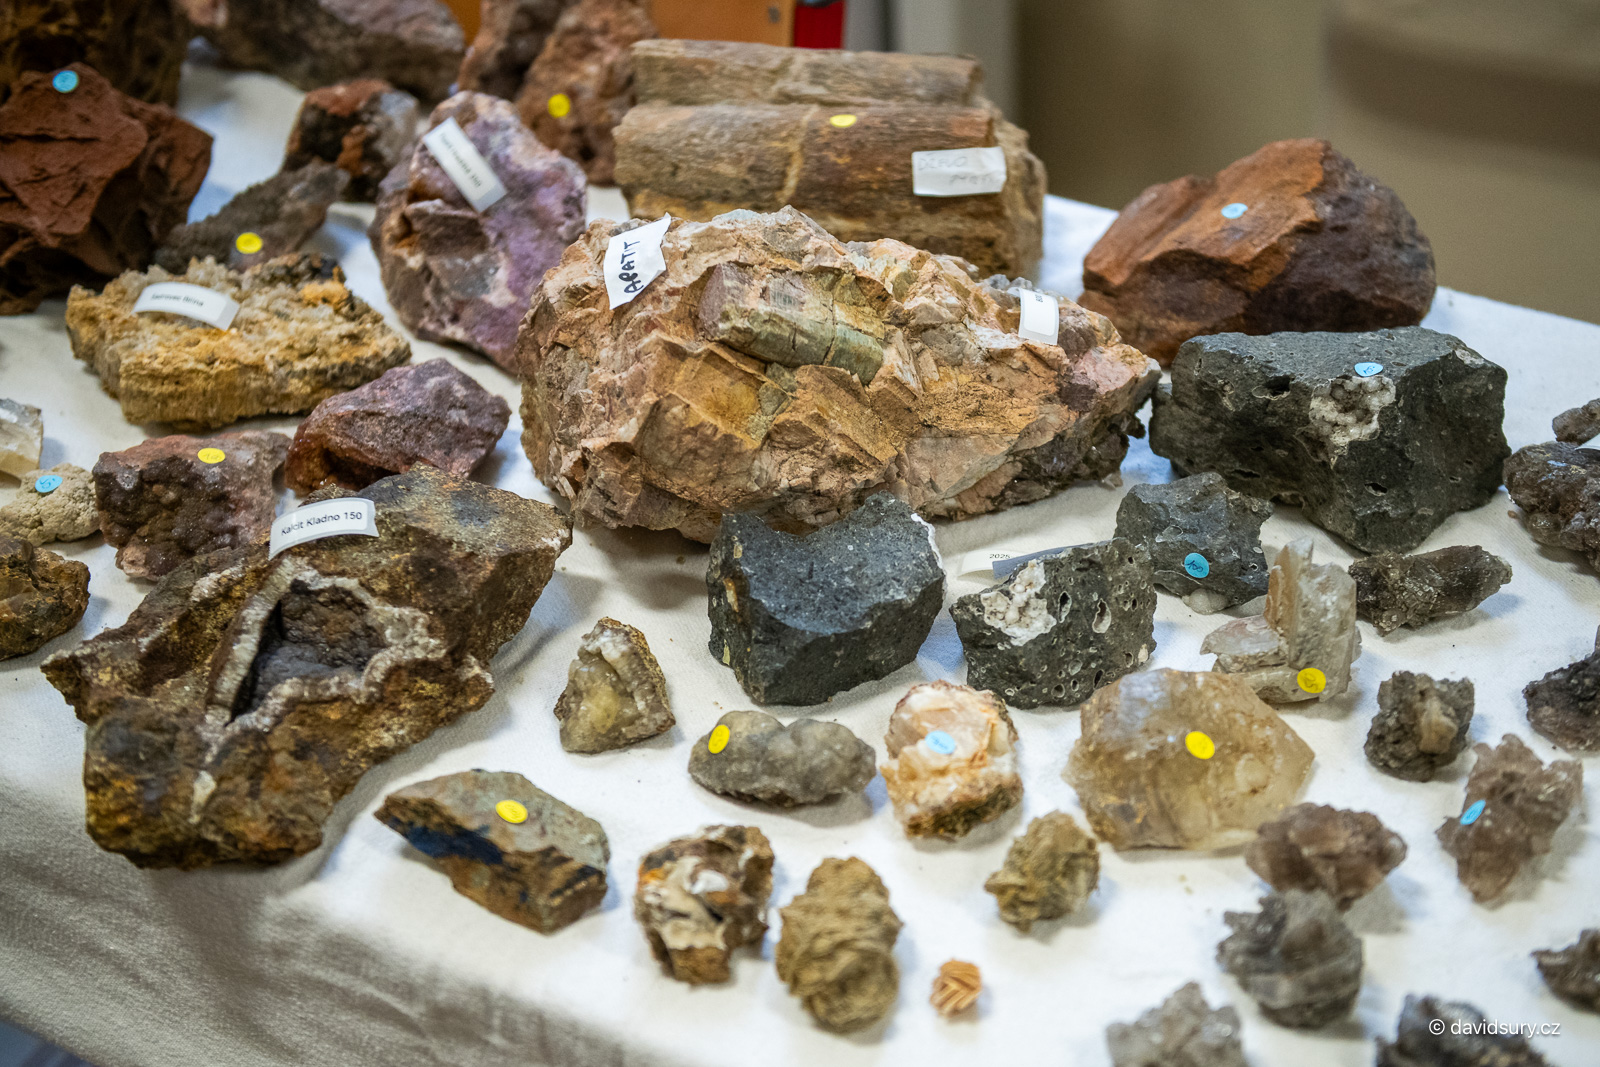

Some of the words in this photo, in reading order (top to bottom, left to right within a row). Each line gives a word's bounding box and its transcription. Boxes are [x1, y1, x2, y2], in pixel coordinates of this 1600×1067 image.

[618, 240, 645, 294] APATIT
[281, 521, 304, 536] Kalcit
[306, 513, 341, 526] Kladno
[343, 511, 363, 520] 150
